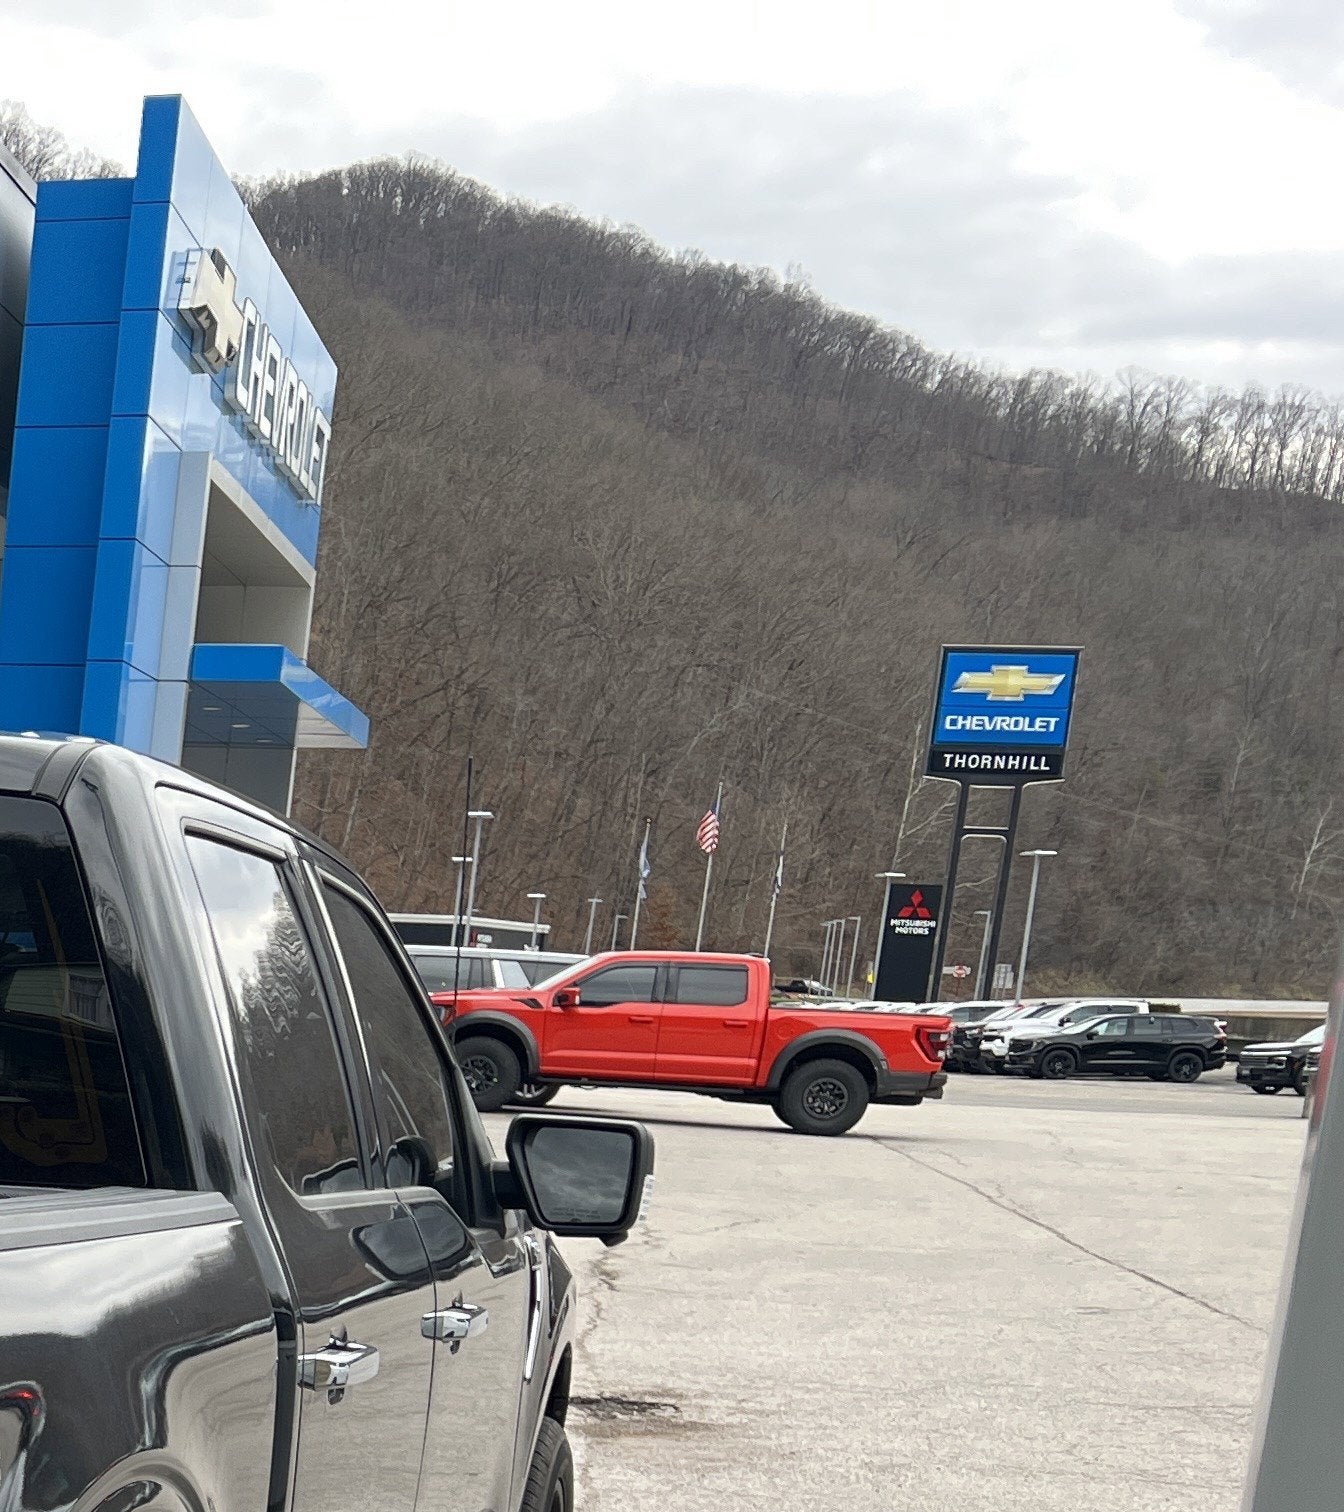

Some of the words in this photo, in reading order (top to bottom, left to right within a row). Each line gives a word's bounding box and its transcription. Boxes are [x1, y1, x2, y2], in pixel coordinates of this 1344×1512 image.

[230, 296, 332, 507] CHEVROLET
[944, 715, 1060, 732] CHEVROLET
[943, 753, 1051, 771] THORNHILL
[890, 918, 936, 928] MITSUBISHI
[894, 927, 929, 935] MOTORS
